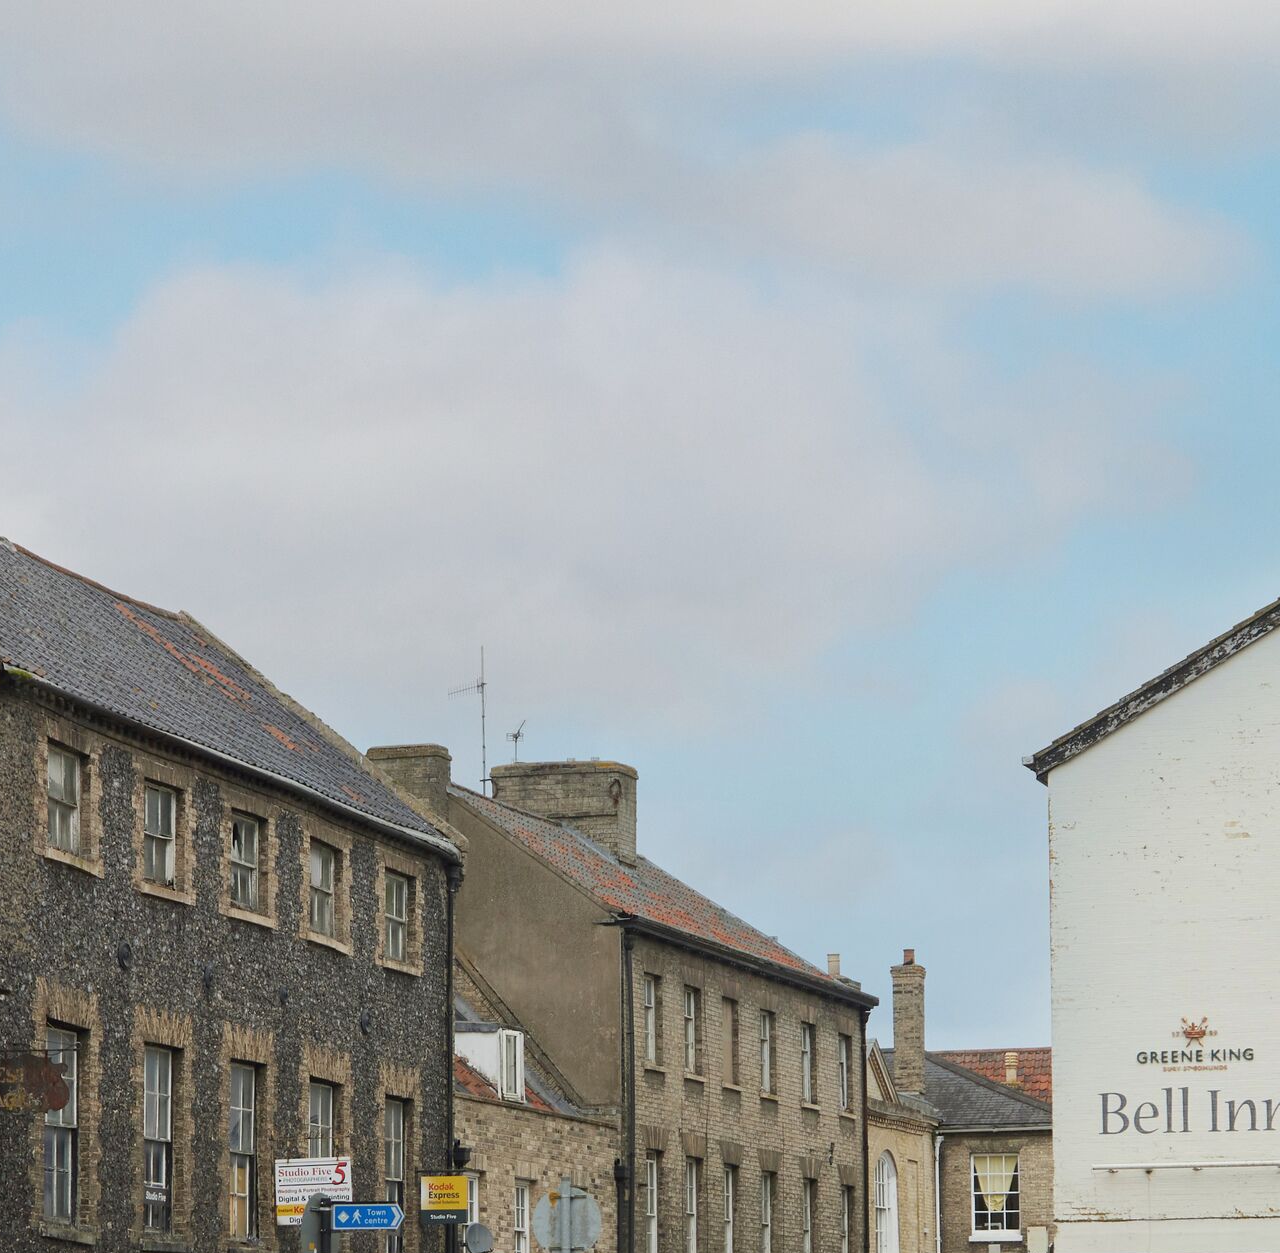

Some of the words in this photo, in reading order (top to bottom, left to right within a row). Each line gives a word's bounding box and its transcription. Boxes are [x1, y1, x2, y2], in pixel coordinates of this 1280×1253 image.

[1137, 1050, 1204, 1064] GREENE
[1211, 1048, 1254, 1062] KING
[1098, 1087, 1192, 1135] Bell
[278, 1168, 310, 1178] Studio
[312, 1167, 332, 1176] Five
[331, 1162, 348, 1185] 5
[428, 1182, 455, 1191] Kodak
[278, 1195, 300, 1203] Digital
[428, 1191, 460, 1200] Express
[366, 1208, 387, 1216] Town
[364, 1216, 389, 1225] centre
